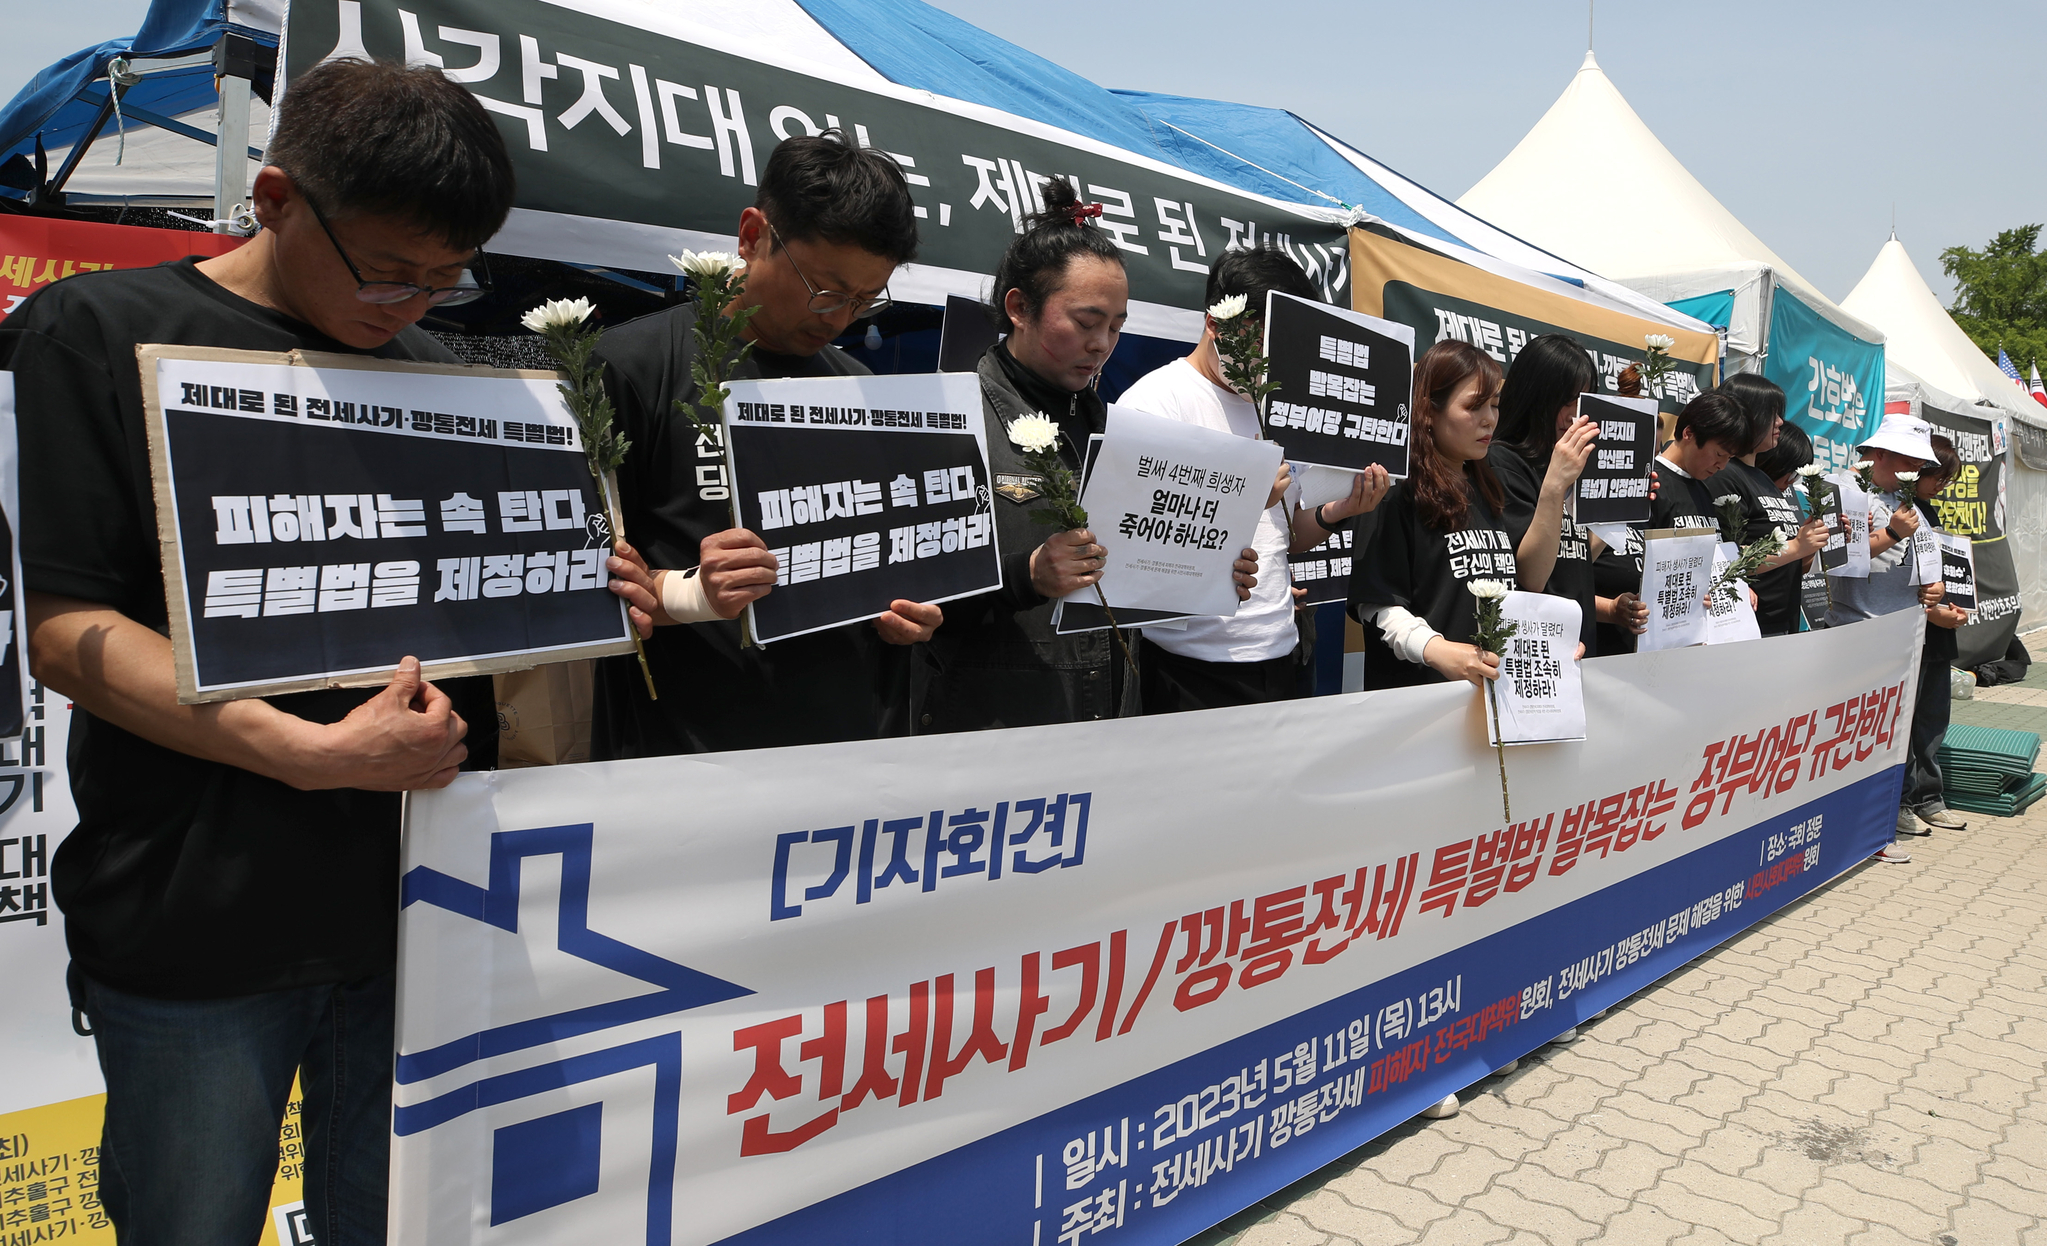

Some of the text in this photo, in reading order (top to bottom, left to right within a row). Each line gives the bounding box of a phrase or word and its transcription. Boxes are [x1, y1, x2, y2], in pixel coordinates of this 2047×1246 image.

[1153, 196, 1210, 275] 된
[1319, 334, 1370, 370] 특별법
[1309, 369, 1376, 407] 발목잡는
[1808, 355, 1867, 430] 간호법은
[180, 382, 574, 446] 제대로 된 전세사기·깡통전세 특별법!
[737, 402, 967, 430] 제대로 된 전세사기·깡통전세 특별법!
[1268, 400, 1408, 447] 정부여당 규탄한다
[1137, 455, 1247, 496] 벌써 4번째 희생자
[211, 489, 586, 545] 피해자는 속 탄다
[758, 465, 976, 531] 피해자는 속 탄다
[1150, 489, 1220, 524] 얼마나 더
[767, 512, 991, 587] 특별법을 제정하라
[1119, 513, 1229, 551] 죽어야 하나요?
[1444, 529, 1498, 555] 전세사기
[1449, 553, 1517, 579] 당신의 책임
[1656, 561, 1673, 573] 피해자
[1665, 571, 1692, 588] 제대로 된
[204, 560, 421, 618] 특별법을
[1657, 585, 1698, 605] 특별법 조속히
[1513, 638, 1550, 659] 제대로 된
[1540, 622, 1564, 637] 달렸다
[1504, 657, 1562, 679] 특별법 조속히
[1806, 813, 1823, 840] 정문
[770, 792, 1092, 921] [기자회견]
[727, 682, 1904, 1157] 전세사기/깡통전세 특별법 발목잡는 정부여당 규탄한다
[1057, 1186, 1126, 1246] 주최
[1150, 1120, 1266, 1209] 전세사기
[1268, 1066, 1367, 1150] 깡통전세
[1368, 1046, 1432, 1096] 피해자
[1433, 976, 1553, 1065] 전국대책위원회,
[1557, 948, 1615, 1001] 전세사기
[1615, 919, 1666, 972] 깡통전세
[1665, 906, 1690, 944] 문제
[1690, 892, 1724, 930] 해결을
[1723, 880, 1745, 913] 위한
[1062, 1118, 1129, 1190] 일시
[1153, 1063, 1268, 1150] 2023년
[1273, 1036, 1318, 1094] 5월
[1323, 1016, 1371, 1069] 11일
[1374, 996, 1414, 1050] (목)
[1417, 975, 1462, 1030] 13시
[0, 1176, 70, 1208] 추홀구
[0, 1197, 73, 1230] 추홀구
